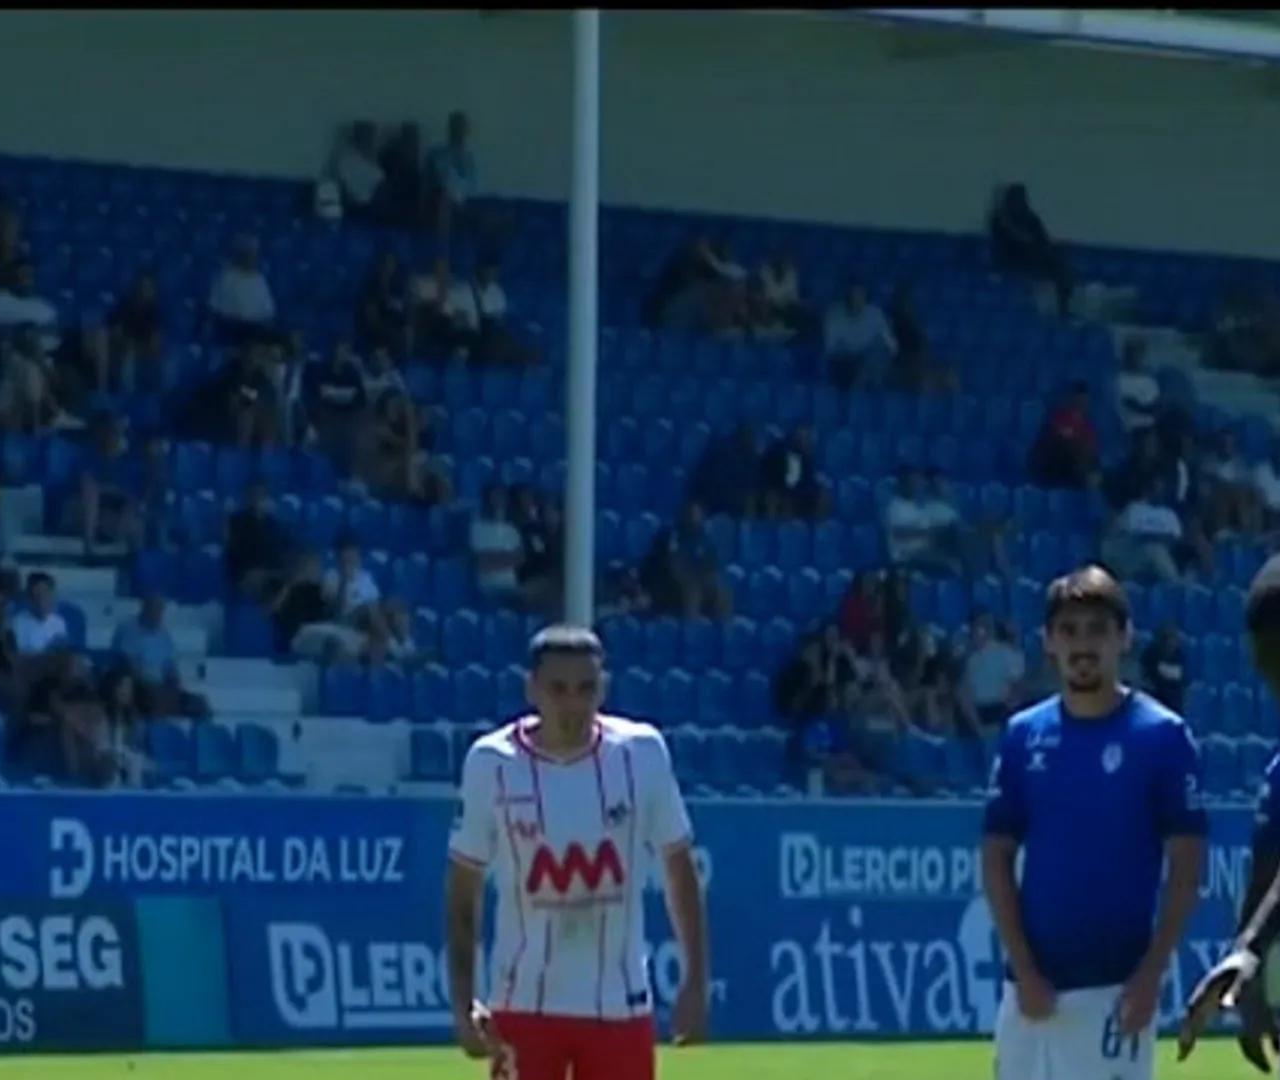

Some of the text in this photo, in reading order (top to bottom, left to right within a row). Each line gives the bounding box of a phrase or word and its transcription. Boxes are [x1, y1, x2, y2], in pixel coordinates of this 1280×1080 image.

[104, 836, 404, 883] HOSPITAL DA LUZ
[824, 846, 945, 891] LERCIO
[769, 905, 970, 1034] ativa
